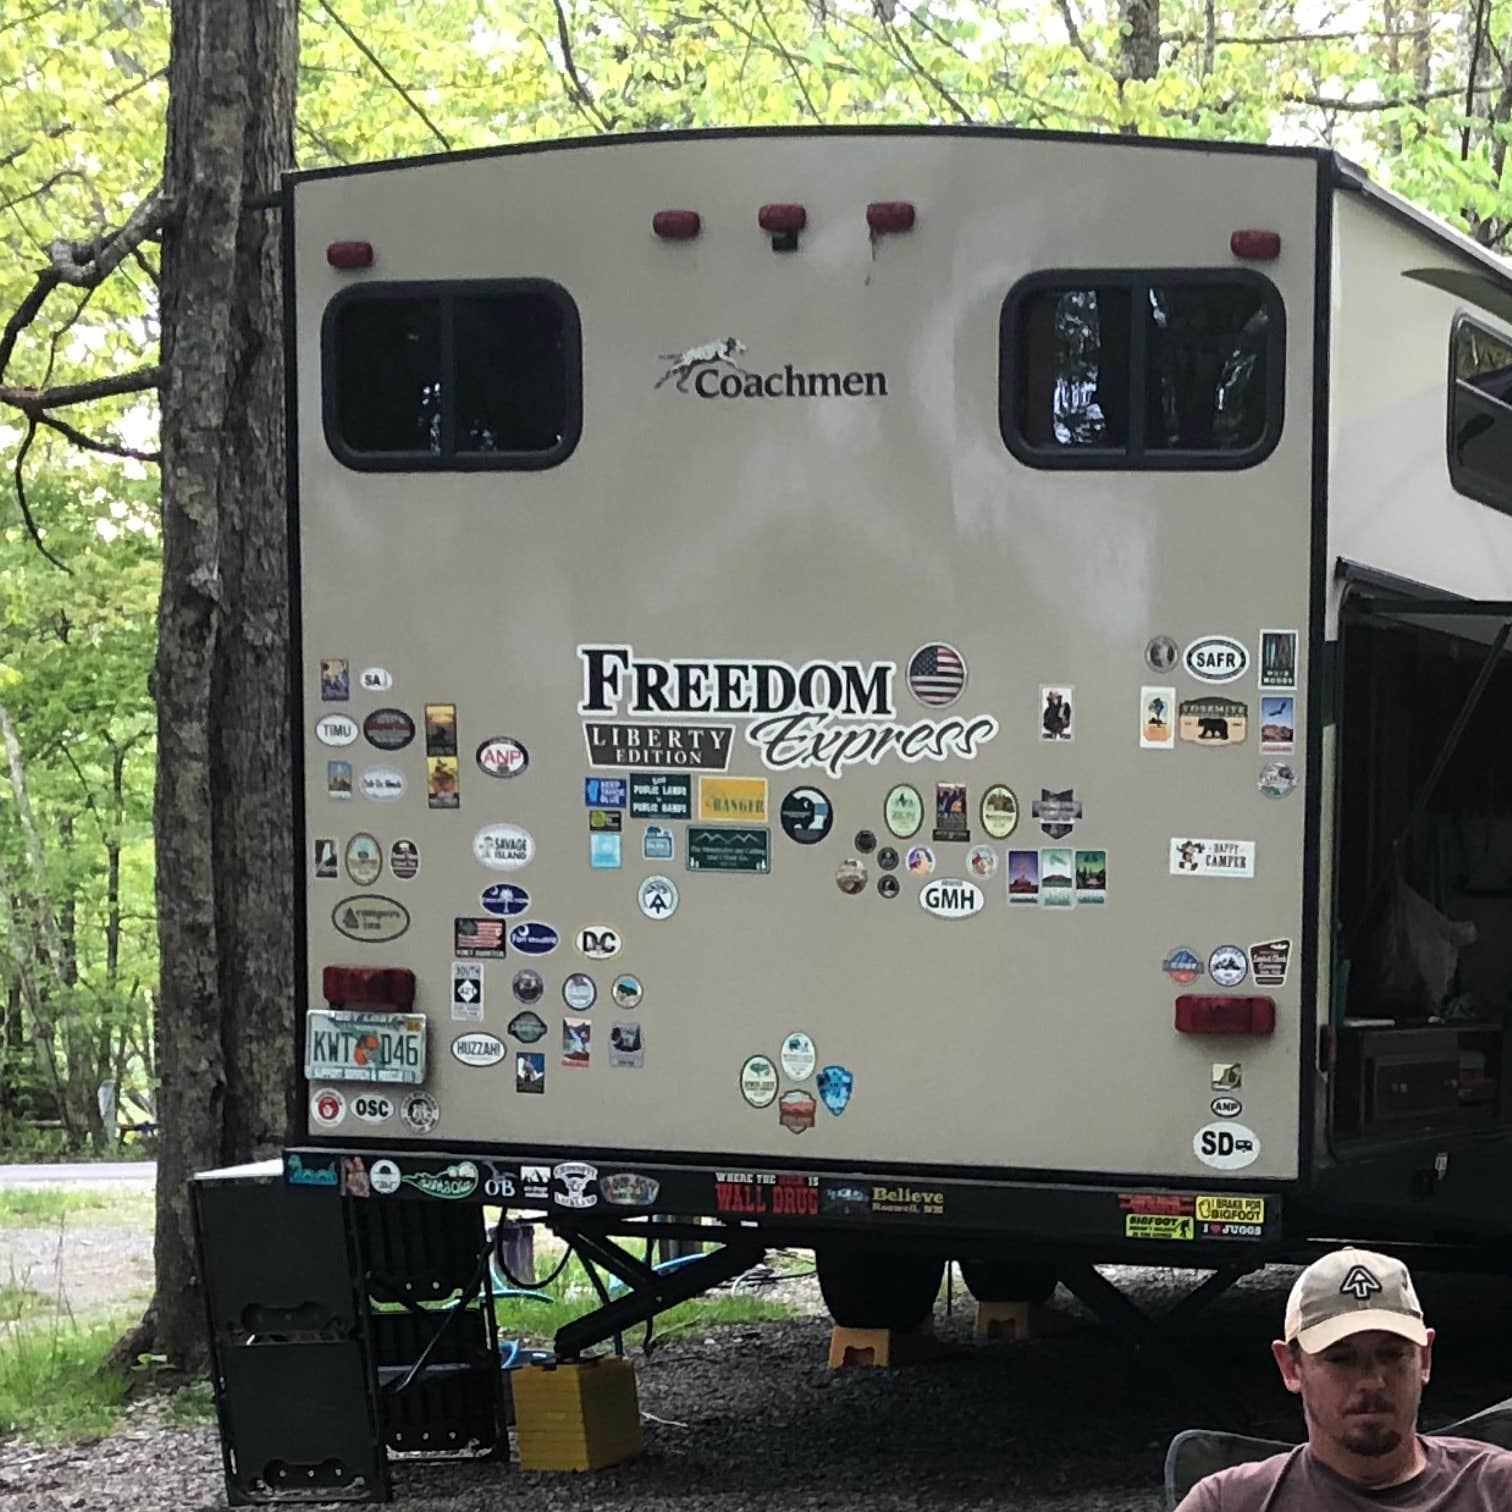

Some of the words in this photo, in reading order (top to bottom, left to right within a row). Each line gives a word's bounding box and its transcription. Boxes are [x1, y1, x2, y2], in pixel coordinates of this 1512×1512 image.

[694, 364, 889, 399] Coachmen
[1196, 652, 1236, 667] SAFR
[580, 648, 895, 715] FREEDOM
[1182, 703, 1246, 715] YOSEMITE
[322, 723, 351, 737] TIMU
[592, 727, 726, 751] LIBERTY
[748, 711, 994, 773] Express
[483, 749, 522, 765] ANP
[615, 748, 703, 765] EDITION
[712, 798, 765, 813] RANGER
[495, 837, 527, 852] SAVAGE
[1213, 843, 1239, 855] HAPPY
[494, 851, 527, 860] ISLAND
[1205, 854, 1247, 868] CAMPER
[925, 888, 975, 909] GMH
[582, 931, 617, 953] DC
[313, 1031, 353, 1063] KWT
[456, 1041, 501, 1058] HUZZAH!
[355, 1098, 389, 1117] OSC
[1201, 1130, 1234, 1156] SD
[714, 1171, 754, 1183] WHERE
[756, 1174, 777, 1184] THE
[808, 1176, 819, 1186] IS
[714, 1183, 768, 1213] WALL
[772, 1186, 819, 1215] DRUG
[871, 1186, 944, 1204] Believe
[1129, 1216, 1178, 1226] BIGFOOT
[1211, 1209, 1261, 1221] BIGFOOT
[1203, 1223, 1209, 1233] I
